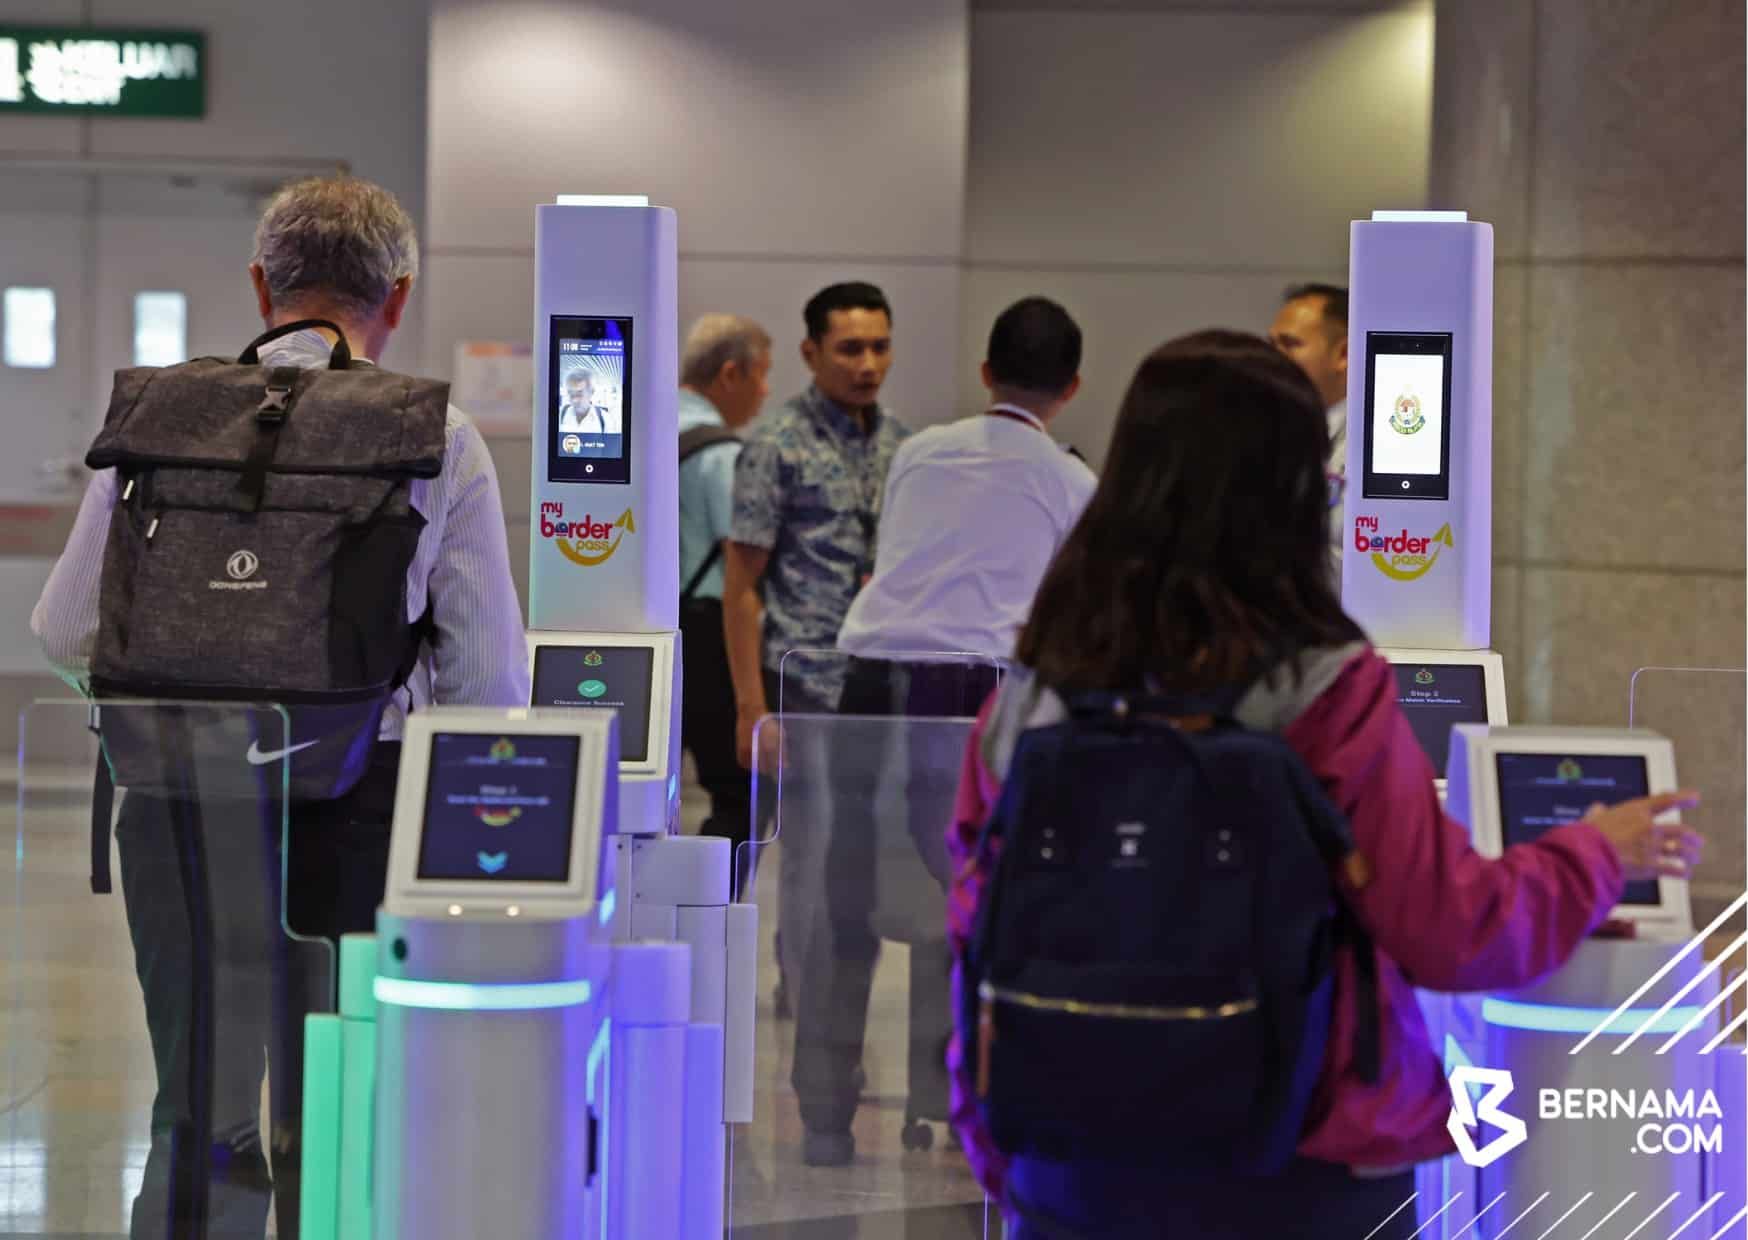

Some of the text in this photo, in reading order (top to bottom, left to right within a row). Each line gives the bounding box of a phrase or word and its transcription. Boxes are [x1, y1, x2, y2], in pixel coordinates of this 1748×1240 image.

[541, 502, 563, 518] my
[541, 513, 614, 539] border
[1355, 515, 1379, 532] my
[576, 540, 609, 552] pass
[1355, 528, 1431, 554] border
[1392, 554, 1426, 567] pass
